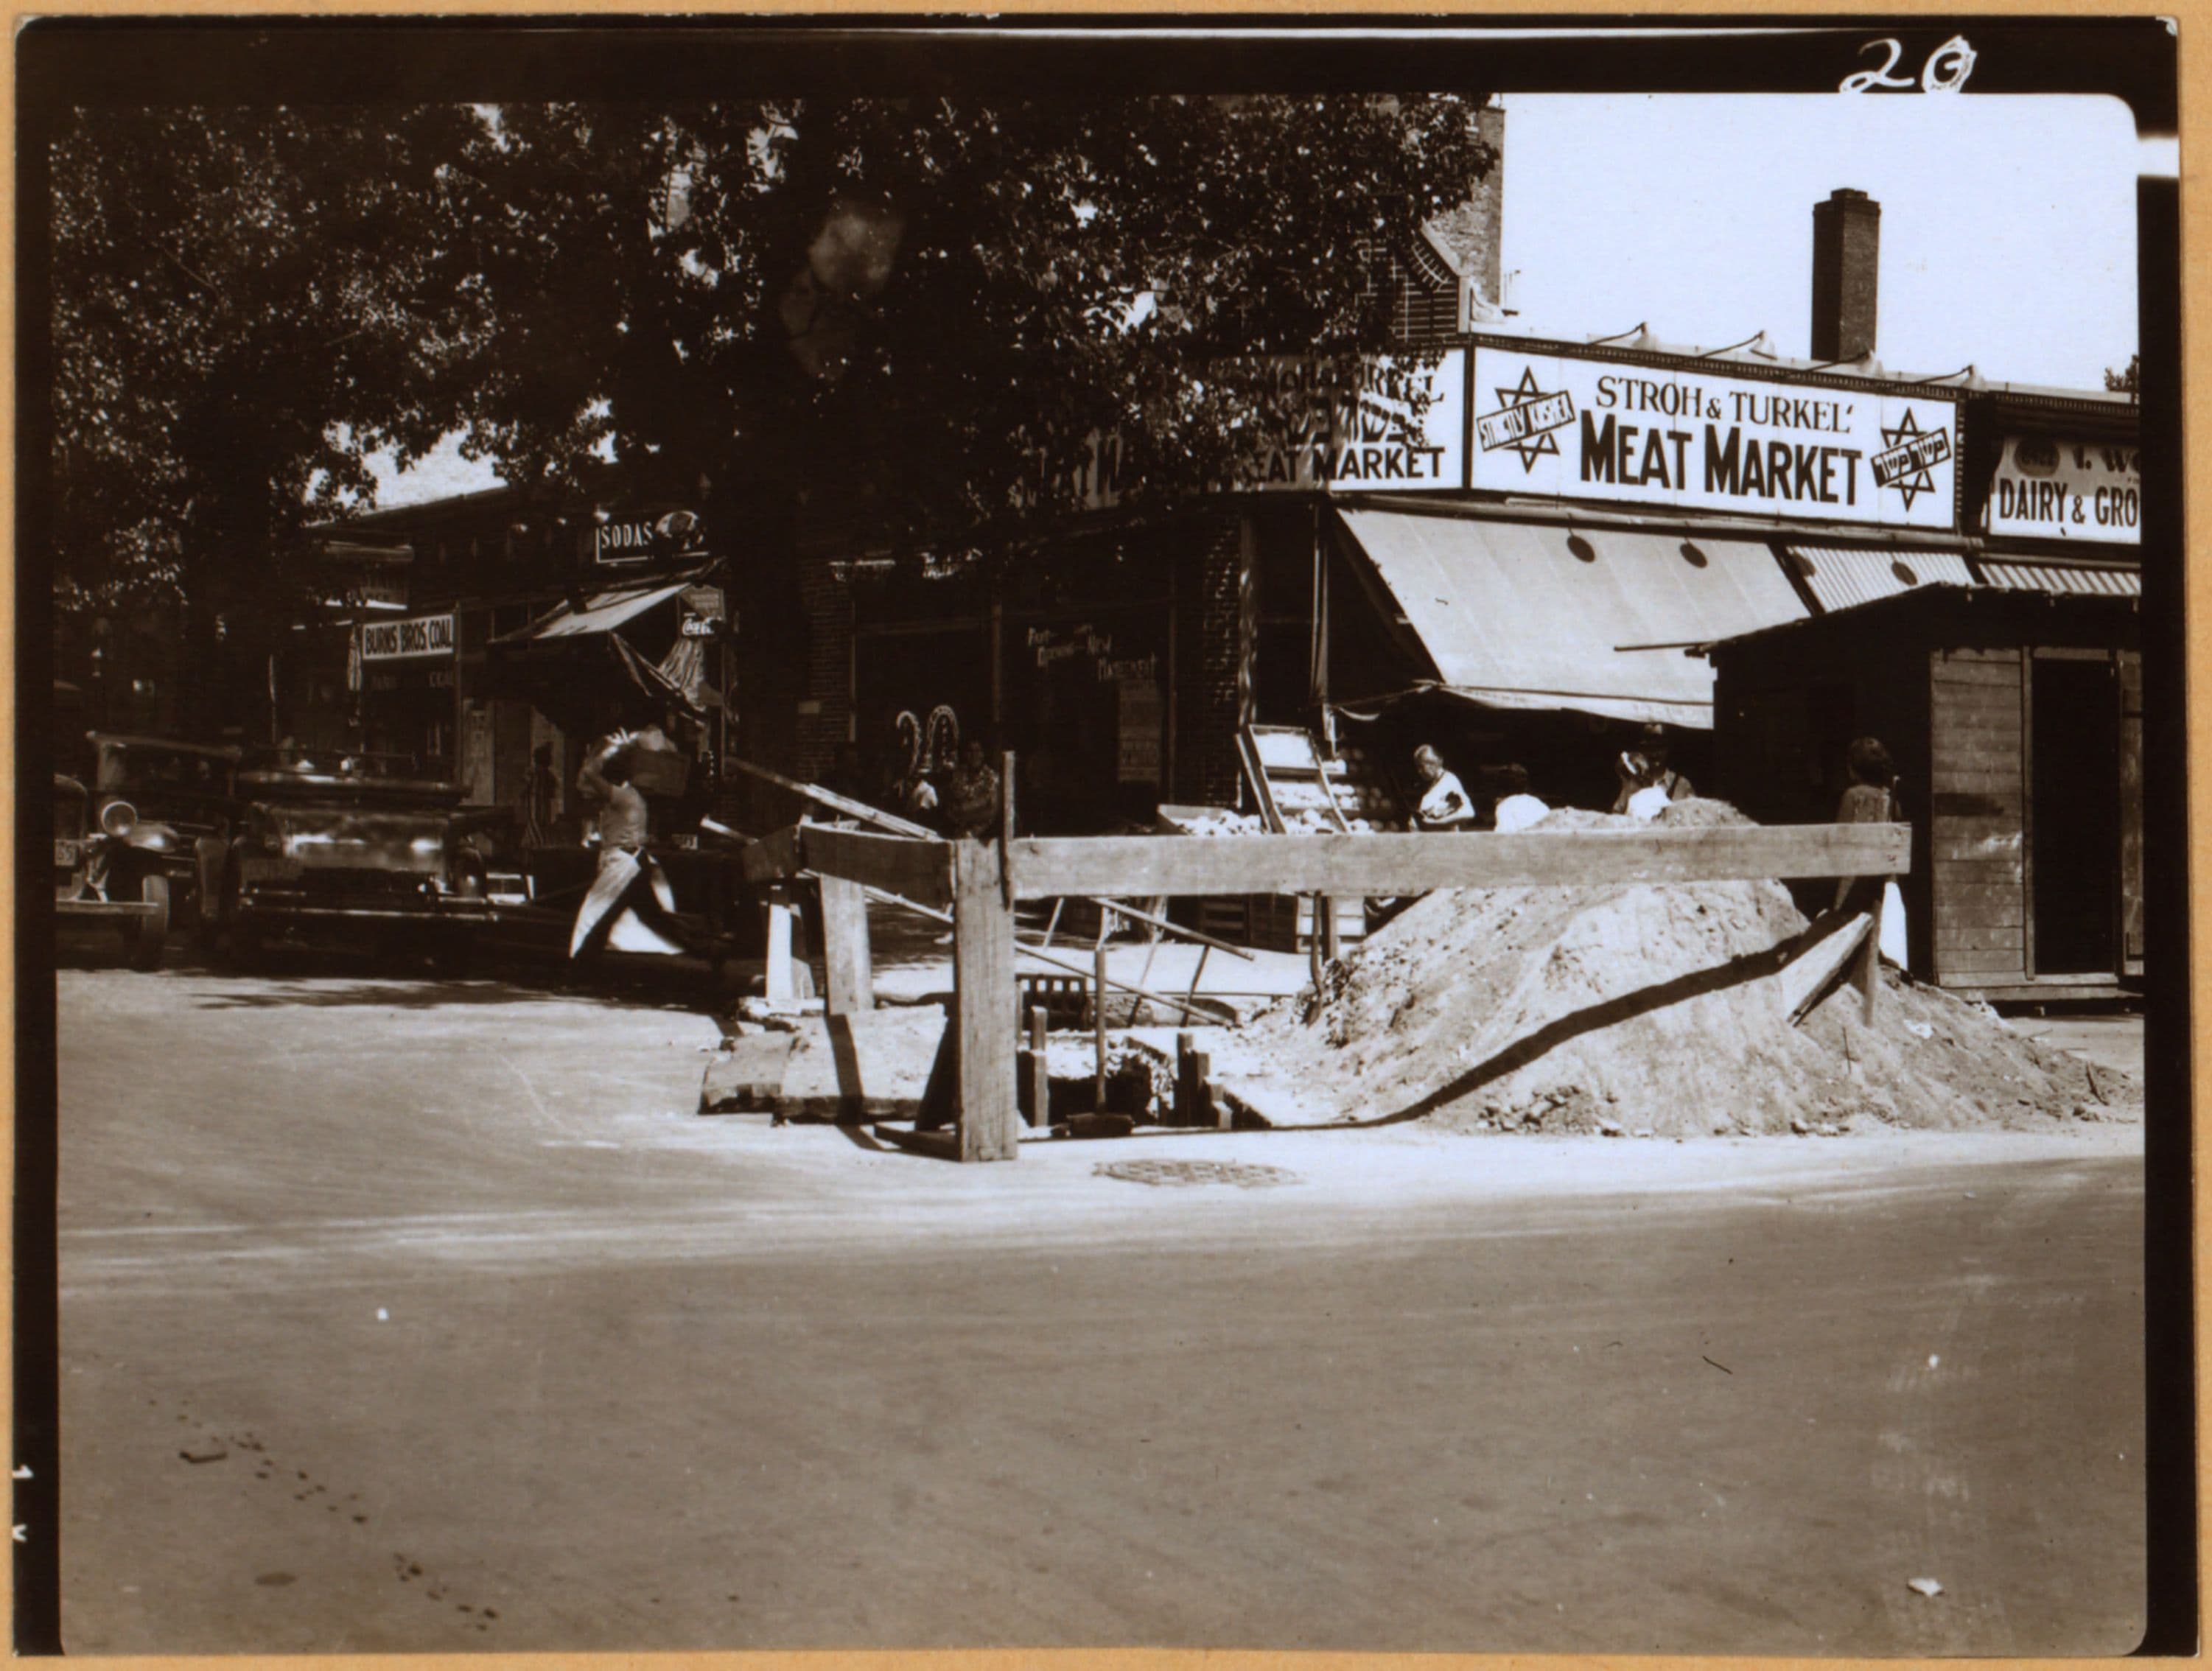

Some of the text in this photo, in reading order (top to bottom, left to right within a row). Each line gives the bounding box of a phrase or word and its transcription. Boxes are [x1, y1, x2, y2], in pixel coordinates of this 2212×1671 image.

[1596, 375, 1703, 418] STROH
[1705, 397, 1722, 420] &
[1312, 446, 1445, 481] MARKET
[1580, 408, 1863, 506] MEAT MARKET
[1998, 477, 2138, 528] DAIRY & GRO
[601, 520, 654, 550] SODAS
[365, 626, 398, 655] BURNS
[429, 617, 454, 649] COAL
